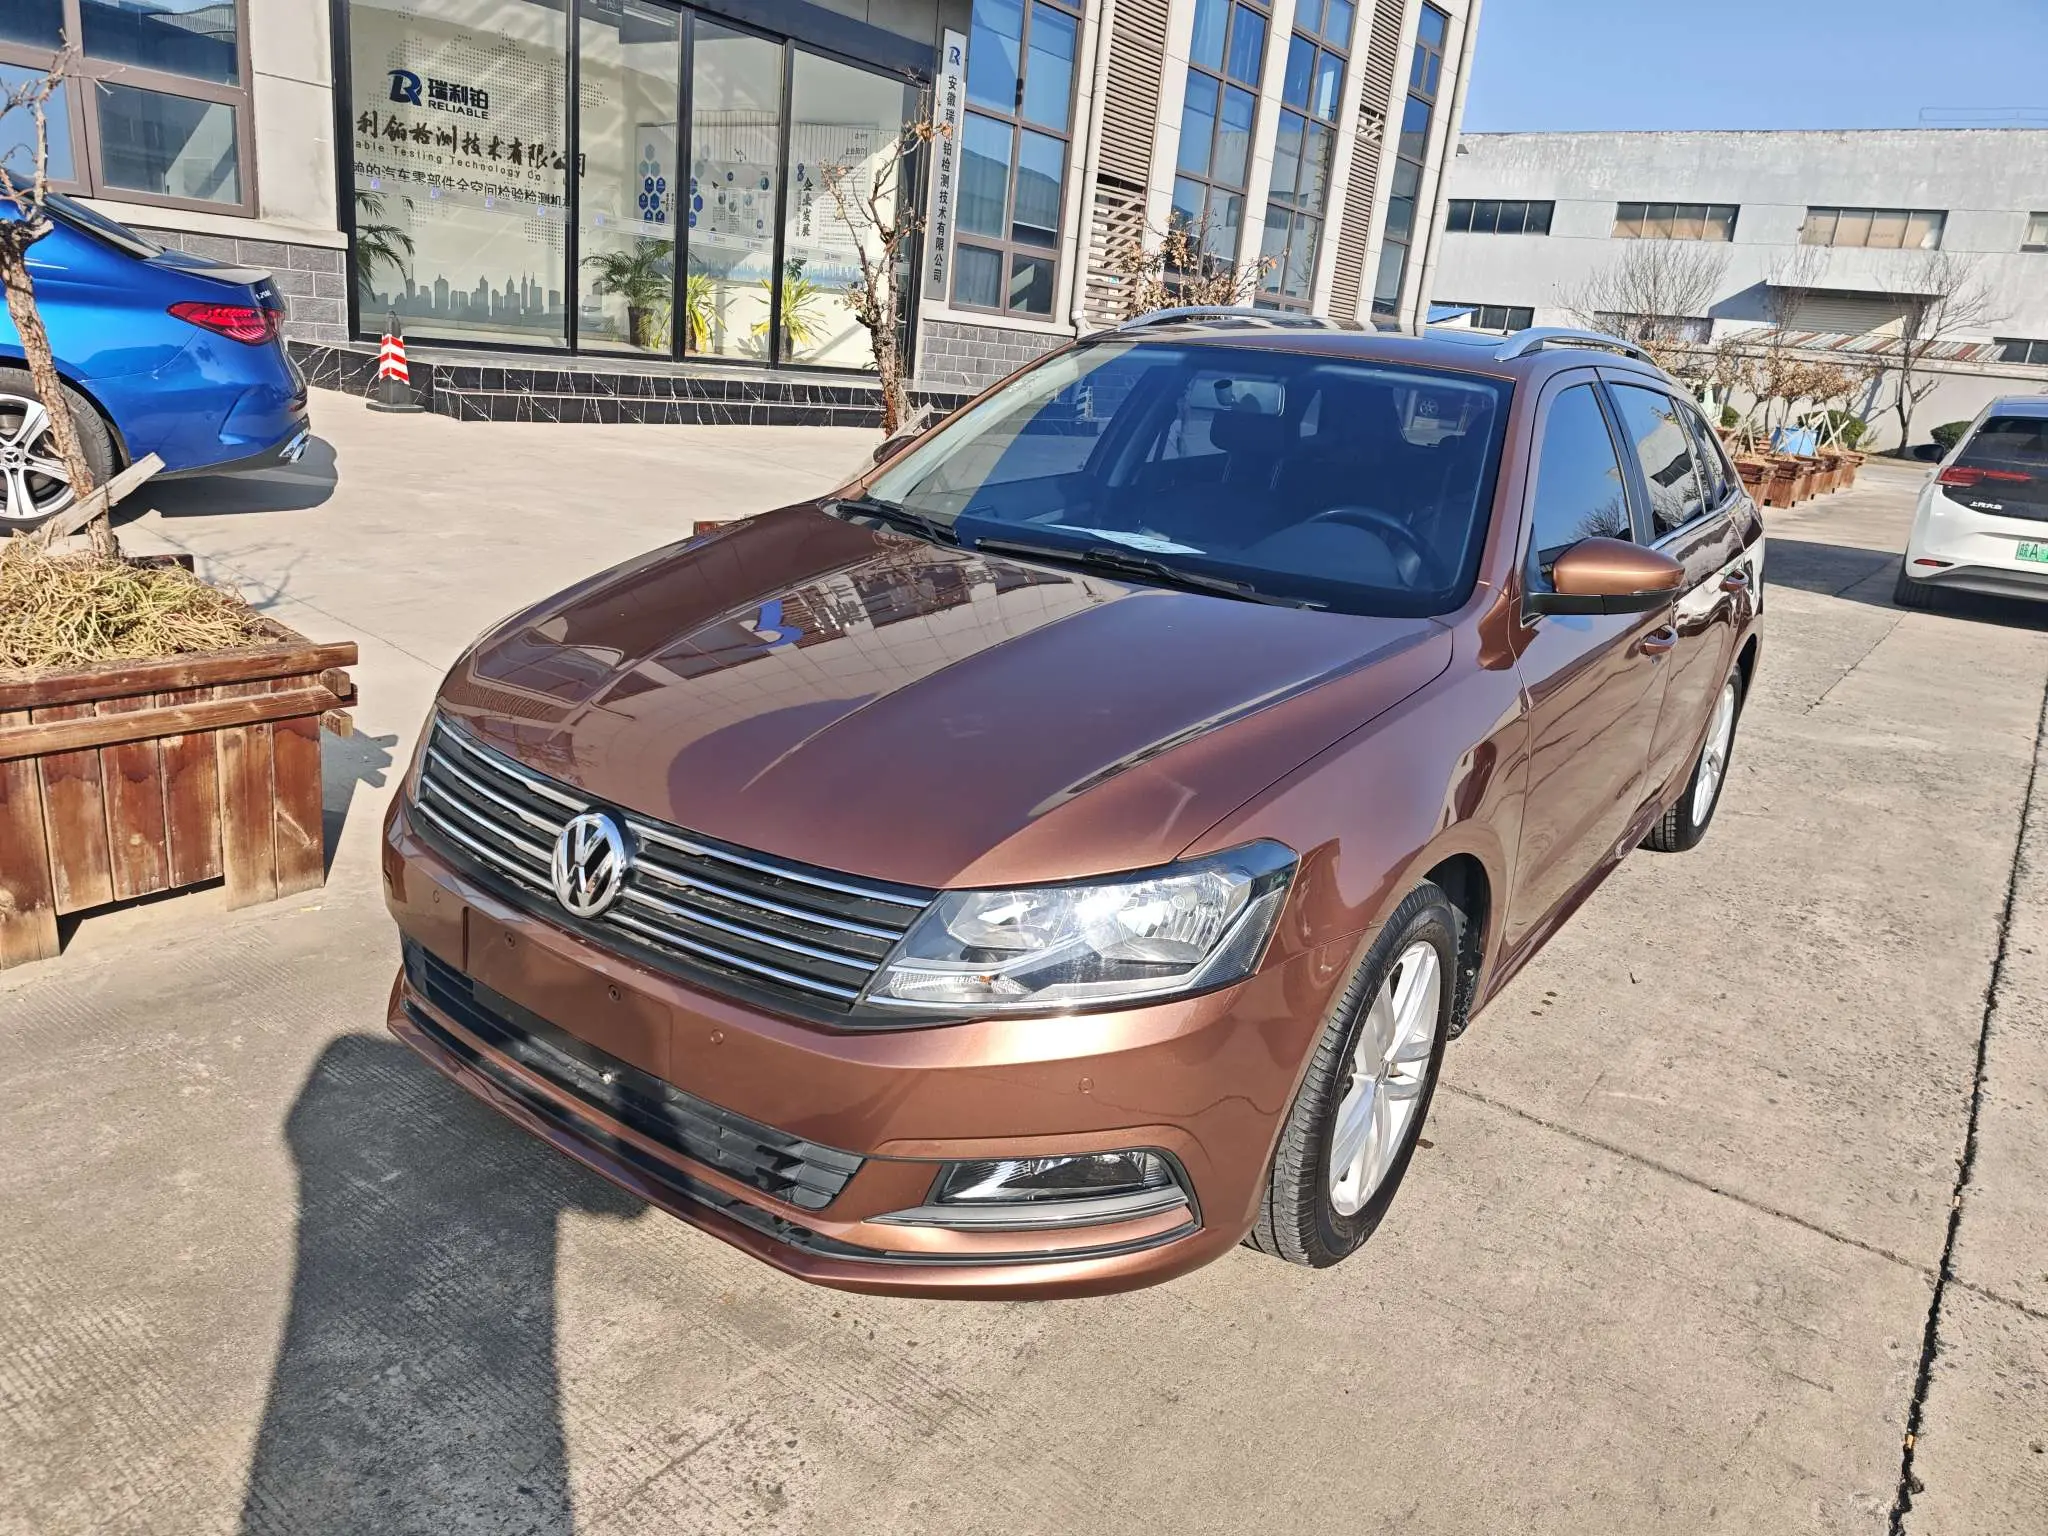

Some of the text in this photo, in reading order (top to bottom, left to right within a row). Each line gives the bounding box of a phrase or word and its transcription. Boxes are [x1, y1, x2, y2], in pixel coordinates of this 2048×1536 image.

[428, 78, 489, 110] 瑞利铂
[428, 99, 489, 120] RELIABLE
[393, 145, 442, 165] Testing
[450, 155, 521, 178] Technology
